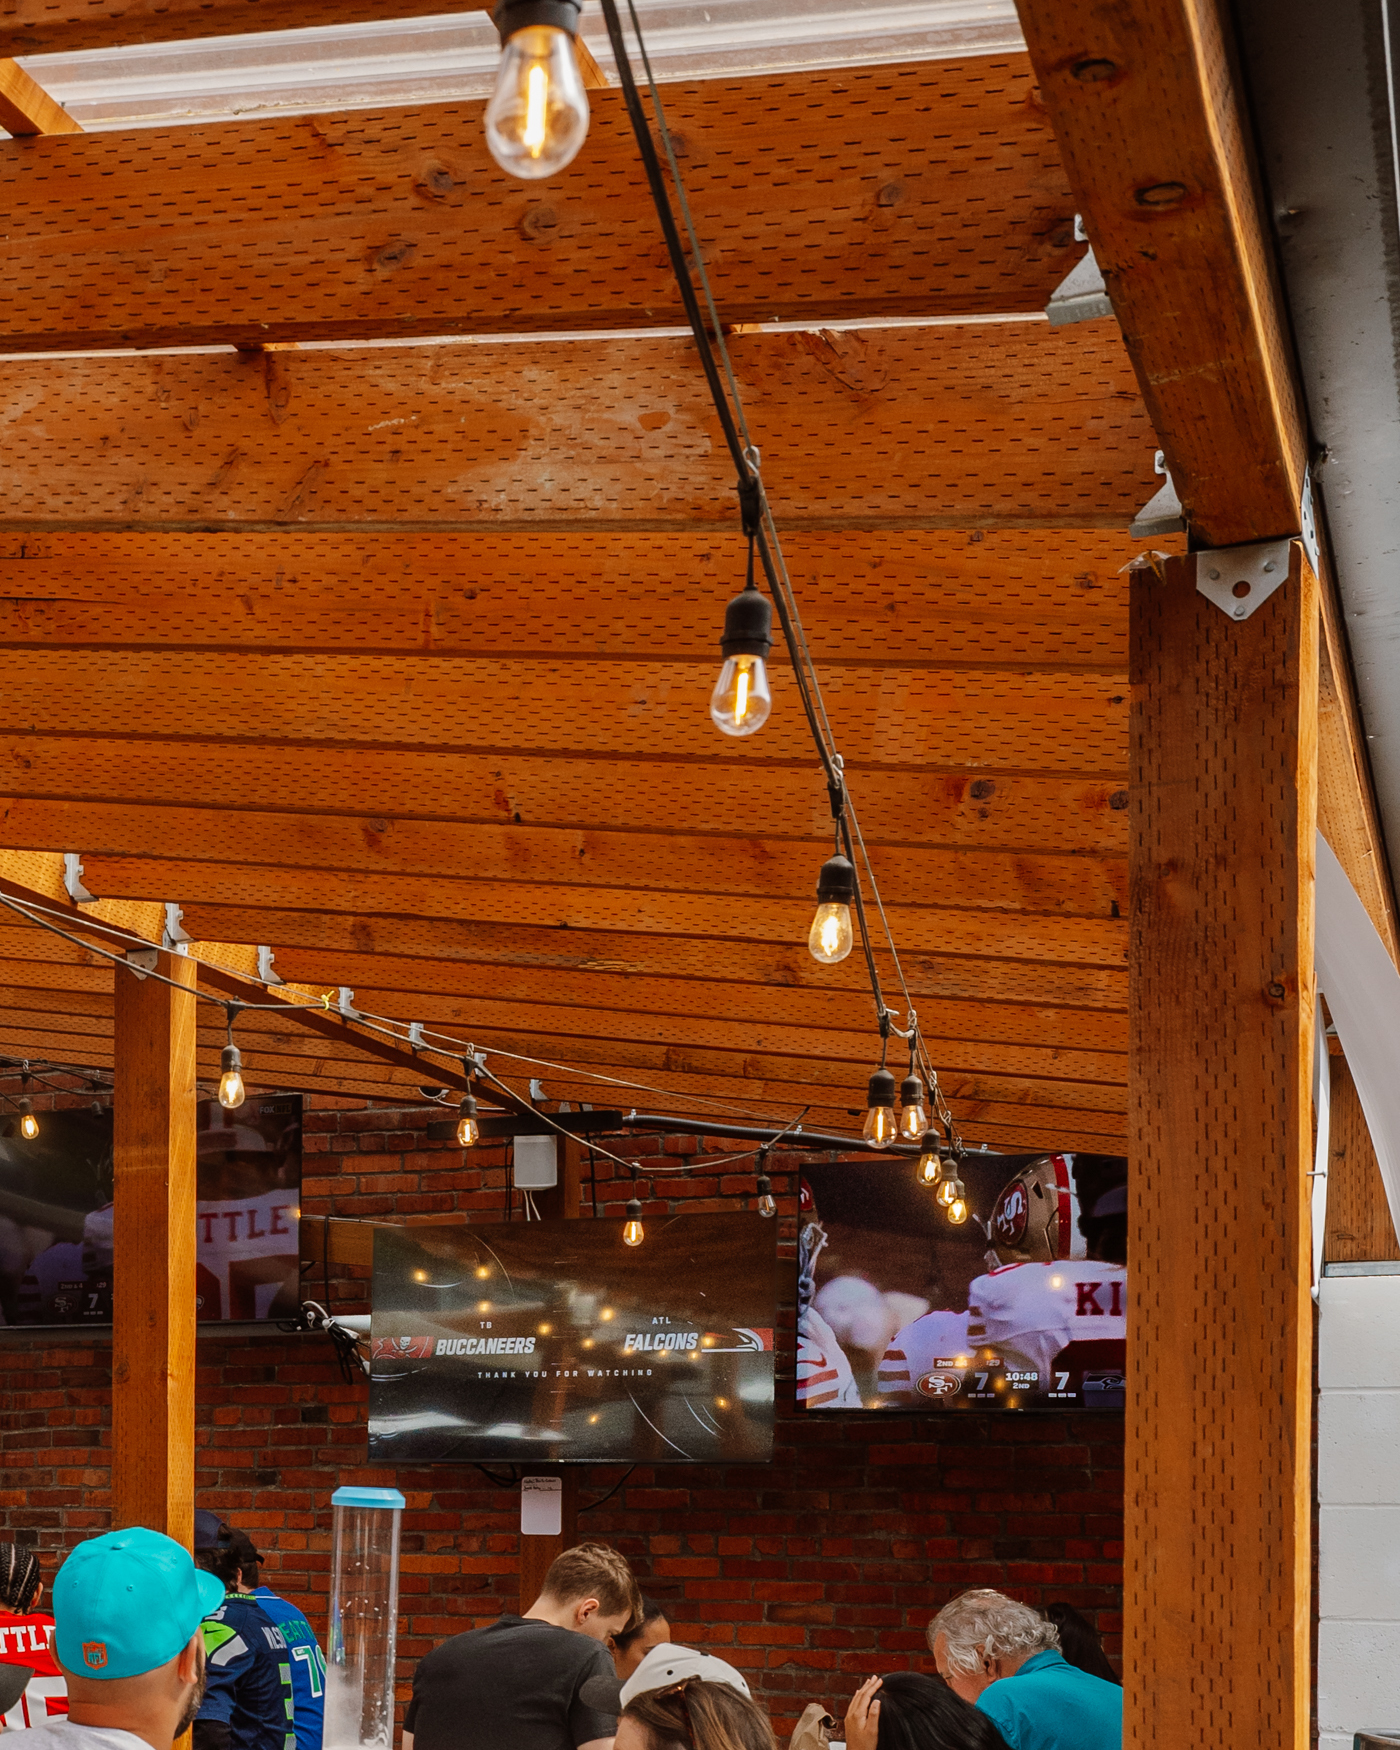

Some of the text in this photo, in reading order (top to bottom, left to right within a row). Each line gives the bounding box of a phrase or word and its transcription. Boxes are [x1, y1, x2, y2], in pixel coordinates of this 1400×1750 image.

[88, 1293, 99, 1309] 7
[1075, 1281, 1122, 1317] KI
[480, 1321, 492, 1329] TB
[651, 1316, 671, 1325] ATL
[435, 1337, 536, 1356] BUCCANEERS
[623, 1332, 698, 1352] FALCONS
[936, 1359, 954, 1367] 2ND
[477, 1369, 653, 1379] THANK YOU FOR WATCHING
[974, 1372, 989, 1391] 7
[1005, 1372, 1038, 1381] 10:48
[1055, 1371, 1070, 1391] 7
